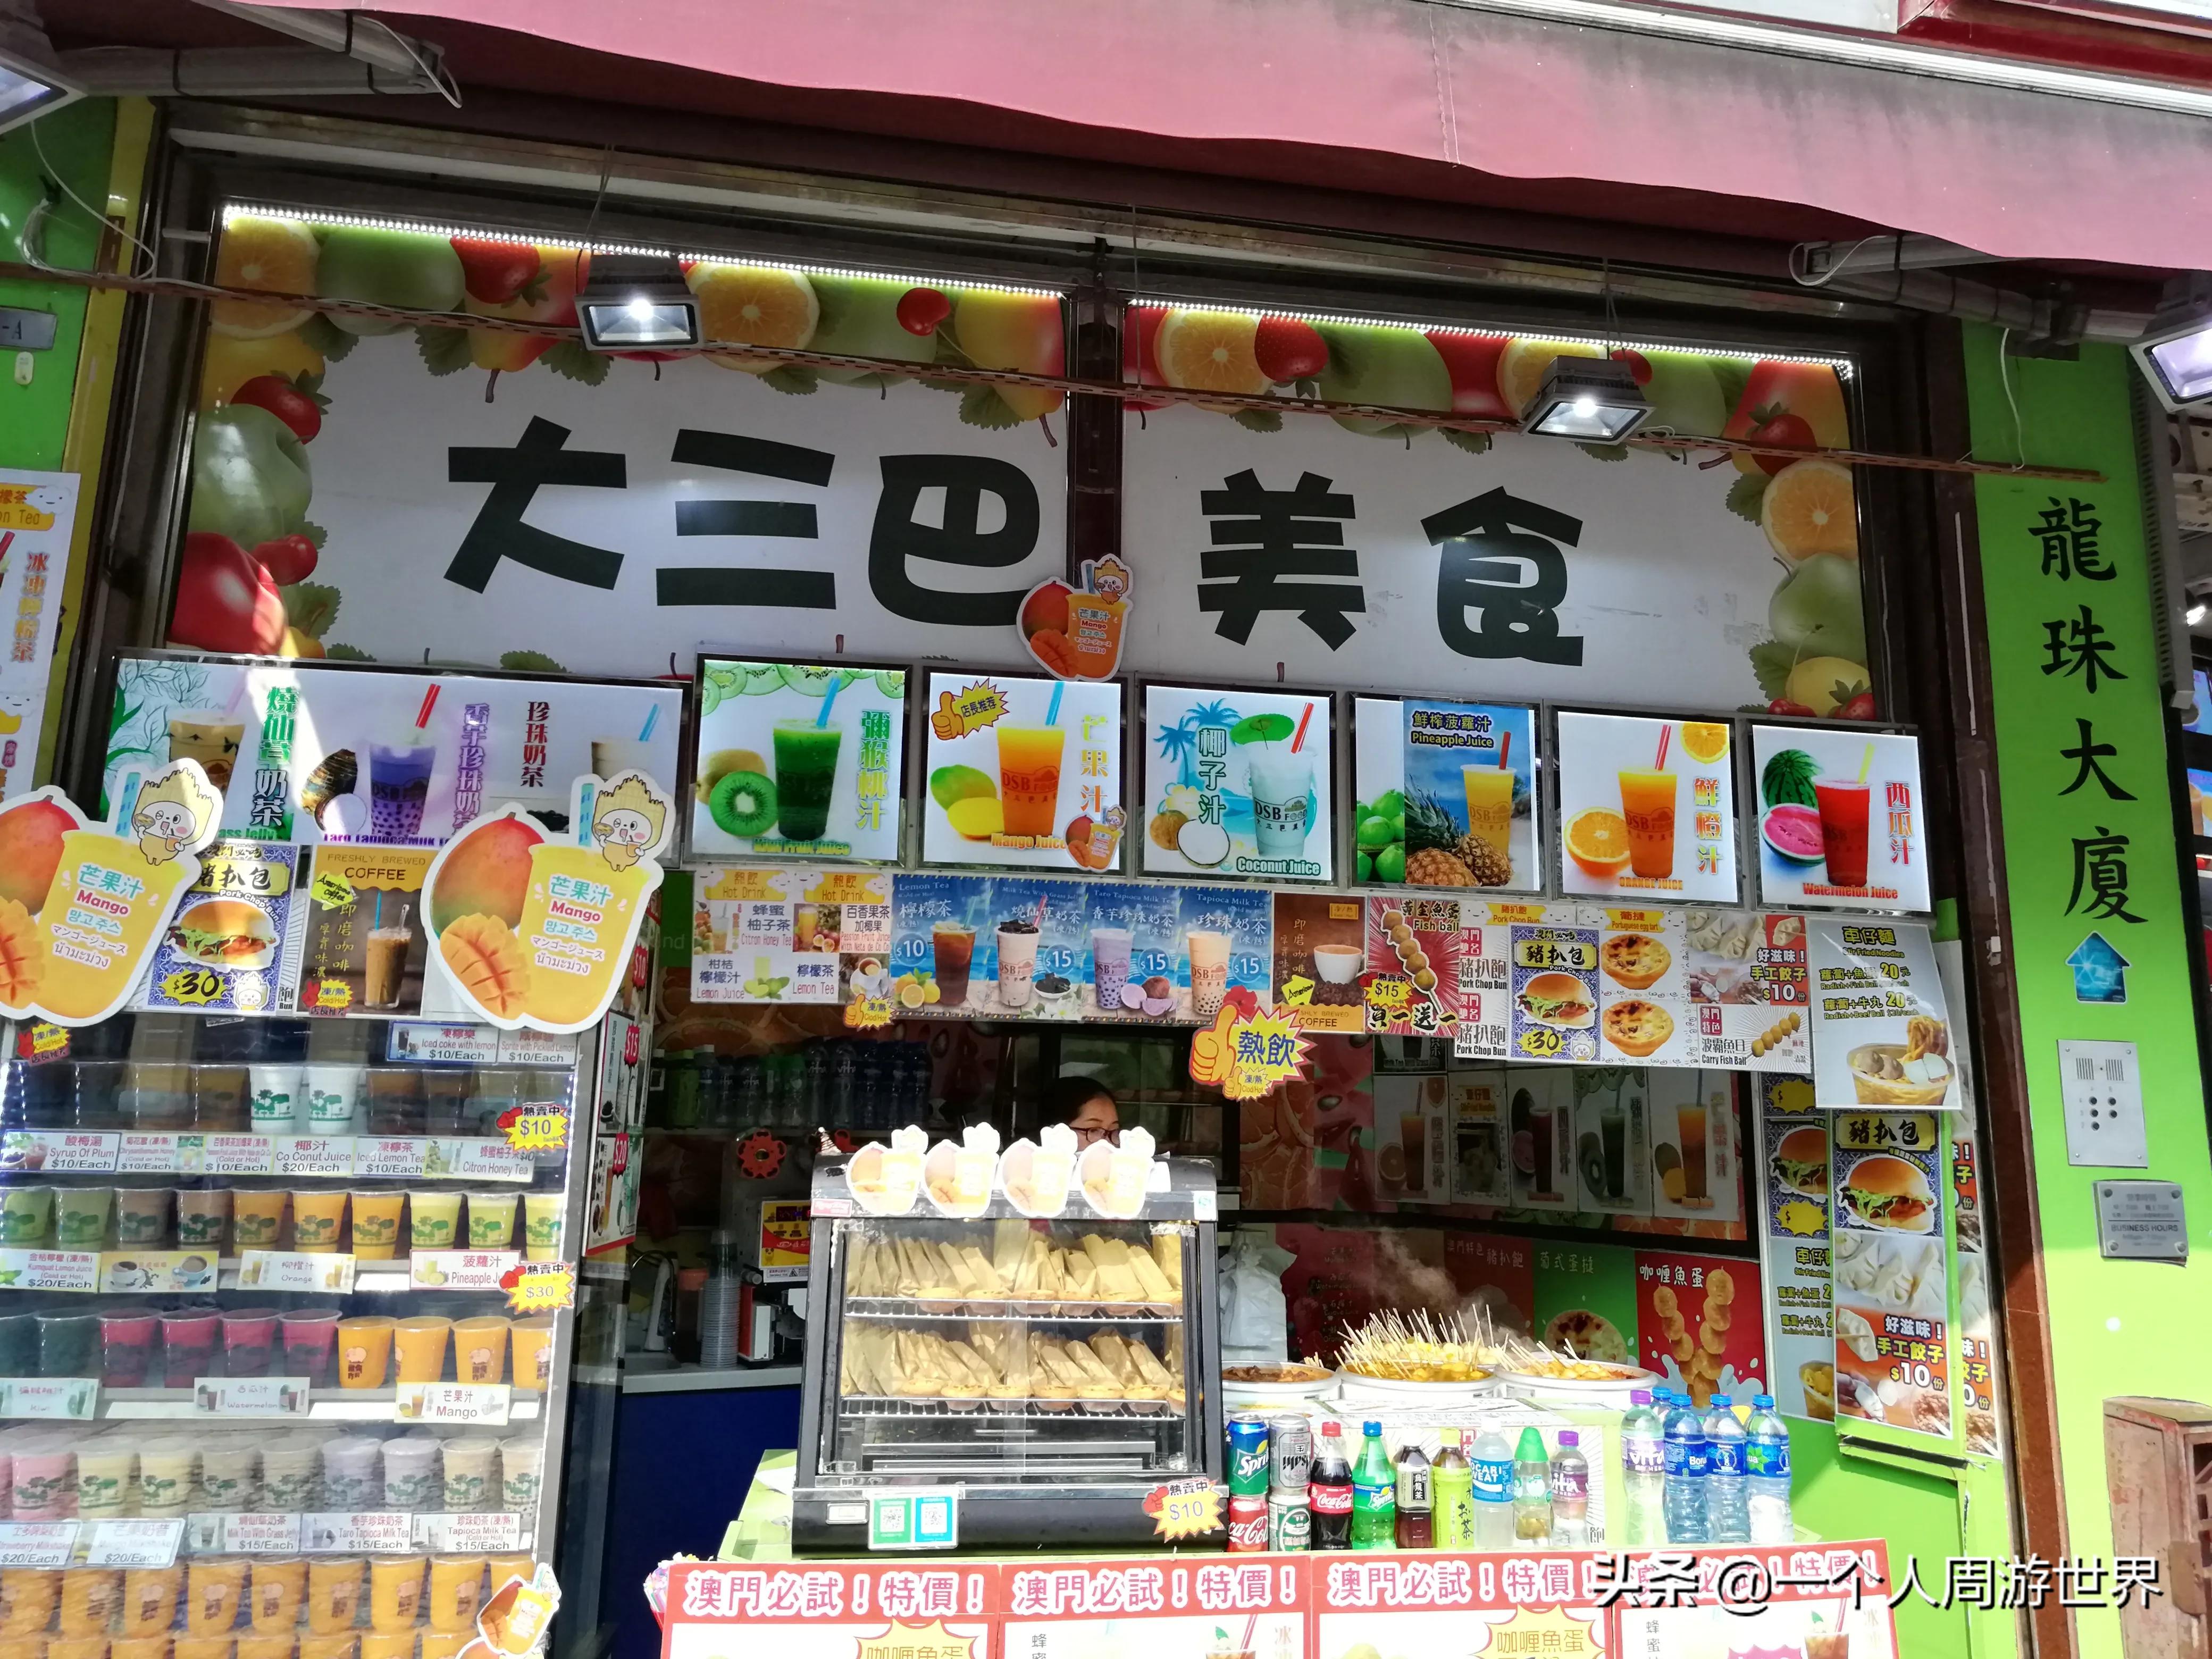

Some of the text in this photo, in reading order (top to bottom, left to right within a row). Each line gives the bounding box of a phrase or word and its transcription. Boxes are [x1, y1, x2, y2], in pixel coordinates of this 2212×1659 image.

[19, 510, 39, 524] Tea
[443, 415, 1583, 667] 大三巴美食
[1079, 608, 1110, 621] 芒果汁
[1082, 621, 1107, 629] Mango
[2028, 496, 2148, 924] 龍珠大廈
[1412, 711, 1492, 732] 鮮榨菠蘿汁
[520, 701, 550, 787] 珍珠奶茶
[1411, 732, 1494, 748] Pineapple Juice
[1003, 772, 1030, 791] DSB
[1199, 727, 1227, 825] 椰子汁
[1255, 801, 1281, 820] DSB
[1886, 781, 1915, 866] 西瓜汁
[991, 833, 1034, 849] Mango
[328, 853, 425, 866] FRESHLY BREWED
[1237, 856, 1321, 875] Coconut Juice
[345, 867, 406, 881] COFFEE
[79, 864, 144, 900] 芒果汁
[1619, 877, 1683, 890] ORANGE JUICE
[550, 875, 612, 906] 芒果汁
[723, 887, 766, 899] Hot Drink
[822, 890, 864, 901] Hot Drink
[1803, 882, 1898, 899] Watermelon Juice
[77, 890, 129, 915] Mango
[1197, 893, 1267, 907] Tapioca Milk Tea
[550, 901, 601, 922] Mango
[752, 904, 785, 916] 蜂蜜
[847, 905, 890, 919] 百香果茶
[899, 900, 952, 919] 檸檬茶
[1092, 906, 1174, 927] 香芋珍珠奶茶
[1402, 901, 1460, 919] 黃金魚蛋
[747, 919, 791, 932] 柚子茶
[854, 920, 882, 932] 加椰果
[1197, 912, 1267, 935] 珍珠奶茶
[1414, 920, 1459, 931] Fish ball
[53, 925, 127, 954] マンゴージュース
[1842, 926, 1897, 945] 車仔麵
[531, 936, 605, 960] マンゴージュース
[896, 940, 925, 957] $10
[1293, 919, 1306, 974] 即磨咖啡
[1046, 950, 1072, 968] $15
[1141, 954, 1166, 970] $15
[1526, 944, 1585, 966] 豬扒包
[1757, 949, 1805, 963] 好滋味！
[797, 965, 834, 978] 檸檬茶
[1234, 958, 1259, 974] $15
[699, 970, 741, 984] 檸檬汁
[1566, 967, 1584, 981] Chop
[1583, 977, 1595, 991] Bun
[1750, 966, 1806, 982] 手工餃子
[173, 971, 220, 997] $30
[792, 982, 834, 994] Lemon Tea
[1375, 983, 1398, 998] $15
[1476, 979, 1492, 990] Chop
[1494, 980, 1507, 990] Bun
[697, 987, 744, 999] Lemon Juice
[1298, 1017, 1337, 1027] COFFEE
[422, 1038, 496, 1050] Iced coke with lemon
[1527, 1031, 1559, 1050] $30
[429, 1050, 485, 1061] $10/Each
[1237, 1030, 1296, 1067] 熱飲
[1457, 1045, 1506, 1056] Pork Chop Bun
[509, 1052, 564, 1063] $10/Each
[1702, 1054, 1747, 1066] Carry Fish Ball
[523, 1105, 560, 1117] 熱賣中
[520, 1119, 551, 1137] $10
[1849, 1118, 1920, 1145] 豬扒包
[50, 1147, 77, 1158] Syrup
[79, 1148, 90, 1157] Of
[92, 1149, 114, 1158] Plum
[295, 1140, 330, 1152] 椰汁
[378, 1142, 414, 1153] 凍檸茶
[52, 1159, 111, 1169] $10/Each
[357, 1152, 426, 1164] Iced Lemon Tea
[282, 1162, 340, 1172] $20/Each
[366, 1163, 423, 1175] $10/Each
[463, 1161, 529, 1176] Citron Honey Tea
[2111, 1224, 2179, 1233] BUSINESS HOURS
[463, 1255, 501, 1268] 菠蘿汁
[527, 1264, 564, 1275] 熱賣中
[1639, 1263, 1704, 1288] 咖喱魚蛋
[28, 1278, 92, 1289] $20/Each
[451, 1271, 491, 1285] Pineapple
[526, 1286, 554, 1298] $30
[1884, 1314, 1942, 1340] 好滋味！
[1876, 1336, 1944, 1364] 手工餃子
[443, 1390, 474, 1402] 芒果汁
[436, 1406, 478, 1418] Mango
[1170, 1481, 1208, 1496] 熱賣中
[1413, 1473, 1425, 1501] 烏龍茶
[1318, 1493, 1353, 1510] Coca-Cola
[1170, 1501, 1203, 1521] $10
[350, 1515, 403, 1526] 香芋珍珠奶茶
[339, 1528, 409, 1539] Taro Tapioca Milk Tea
[448, 1527, 481, 1536] Tapioca
[239, 1540, 294, 1550] $15/Each
[348, 1540, 403, 1550] $15/Each
[455, 1541, 509, 1551] $15/Each
[1, 1554, 59, 1564] $20/Each
[105, 1553, 162, 1563] $20/Each
[1016, 1570, 1296, 1610] 澳門必試！特價！
[1331, 1564, 1594, 1602] 澳門必試！特價！
[688, 1576, 982, 1612] 澳門必試！特價！
[1496, 1629, 1585, 1654] 咖喱魚蛋
